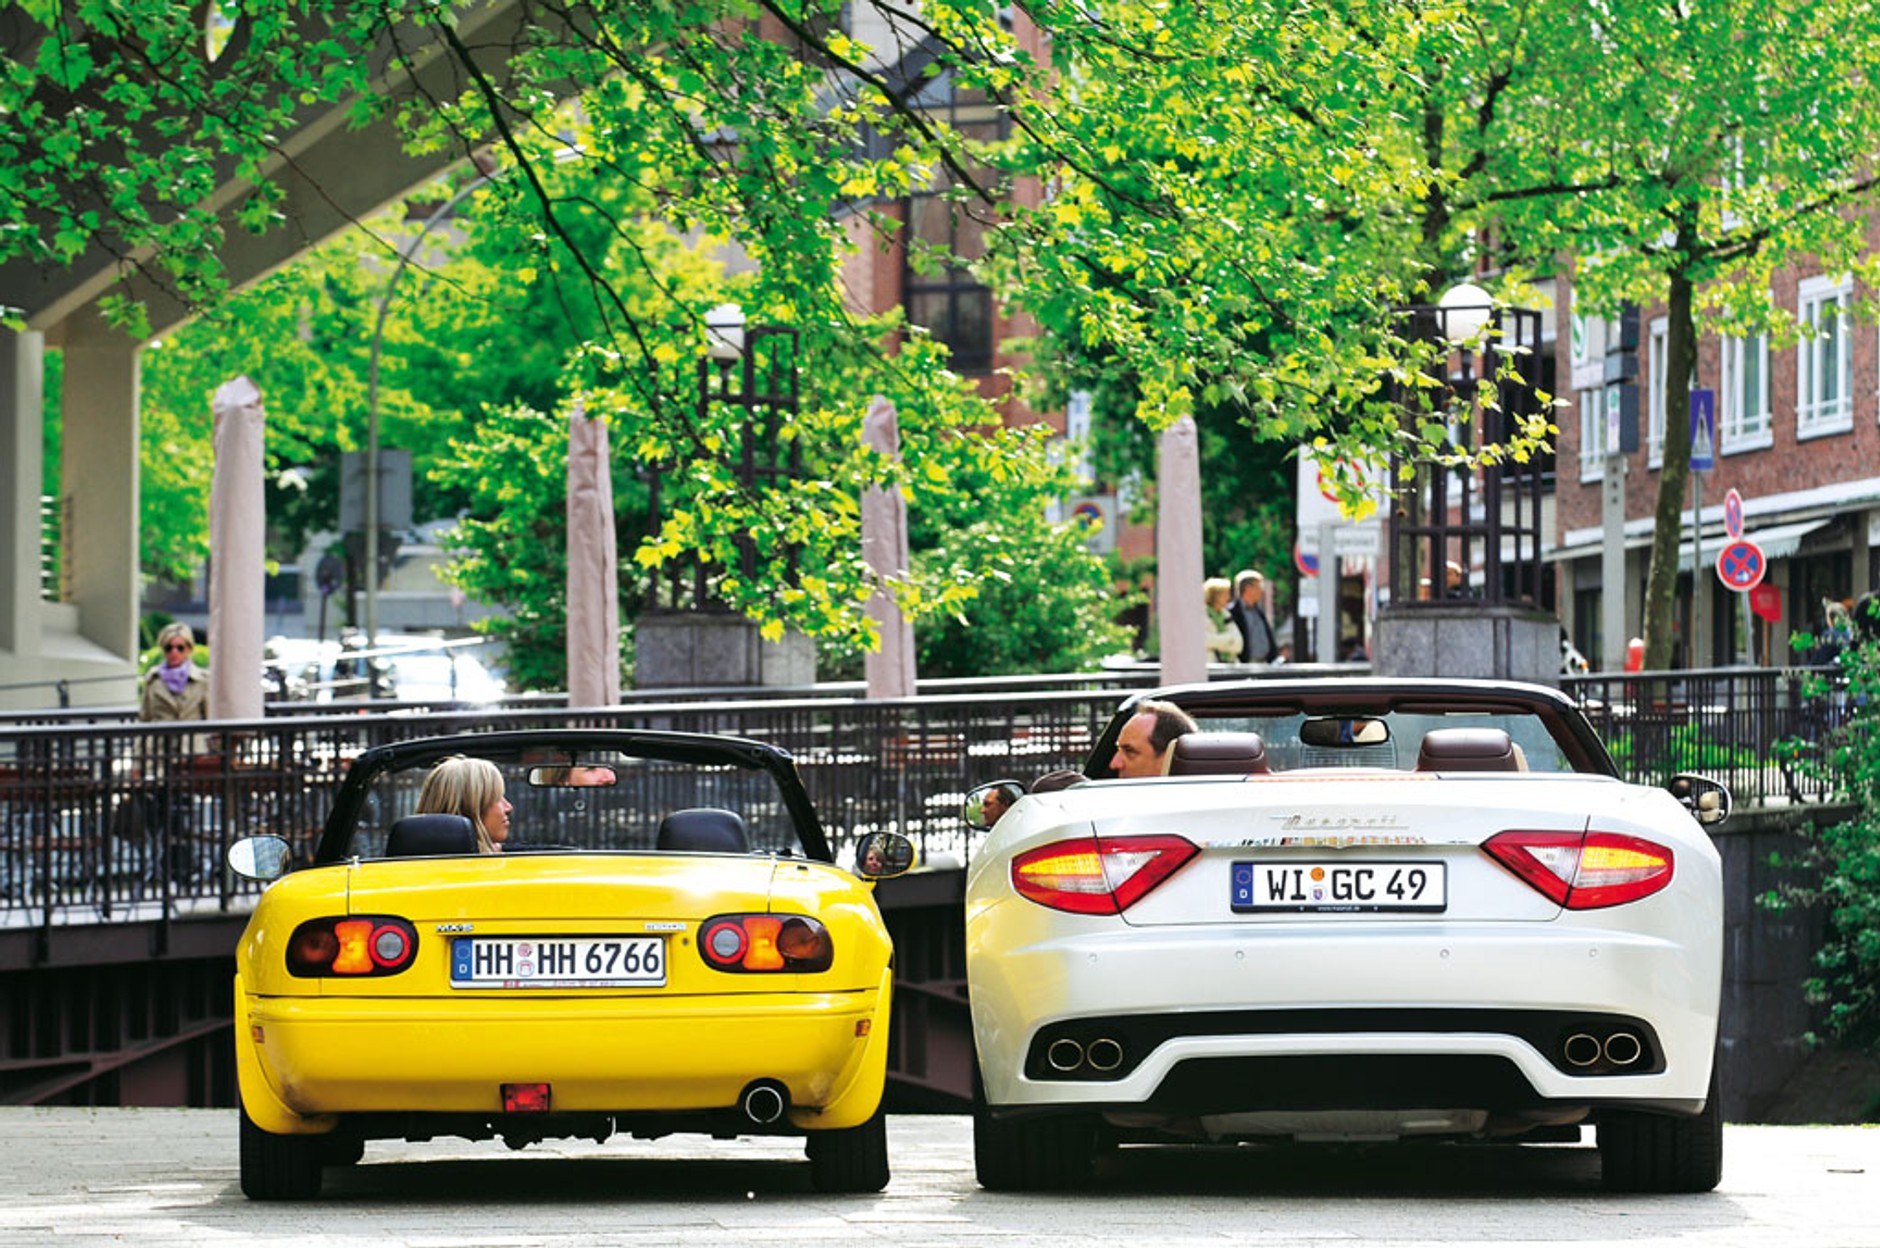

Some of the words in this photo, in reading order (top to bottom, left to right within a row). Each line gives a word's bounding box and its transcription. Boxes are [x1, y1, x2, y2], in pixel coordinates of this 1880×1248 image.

[1239, 888, 1248, 899] D
[1267, 869, 1307, 901] WI
[1332, 869, 1375, 901] GC
[1386, 869, 1427, 901] 49
[458, 963, 468, 974] D
[475, 943, 513, 975] HH
[537, 943, 576, 975] HH
[585, 942, 660, 975] 6766
